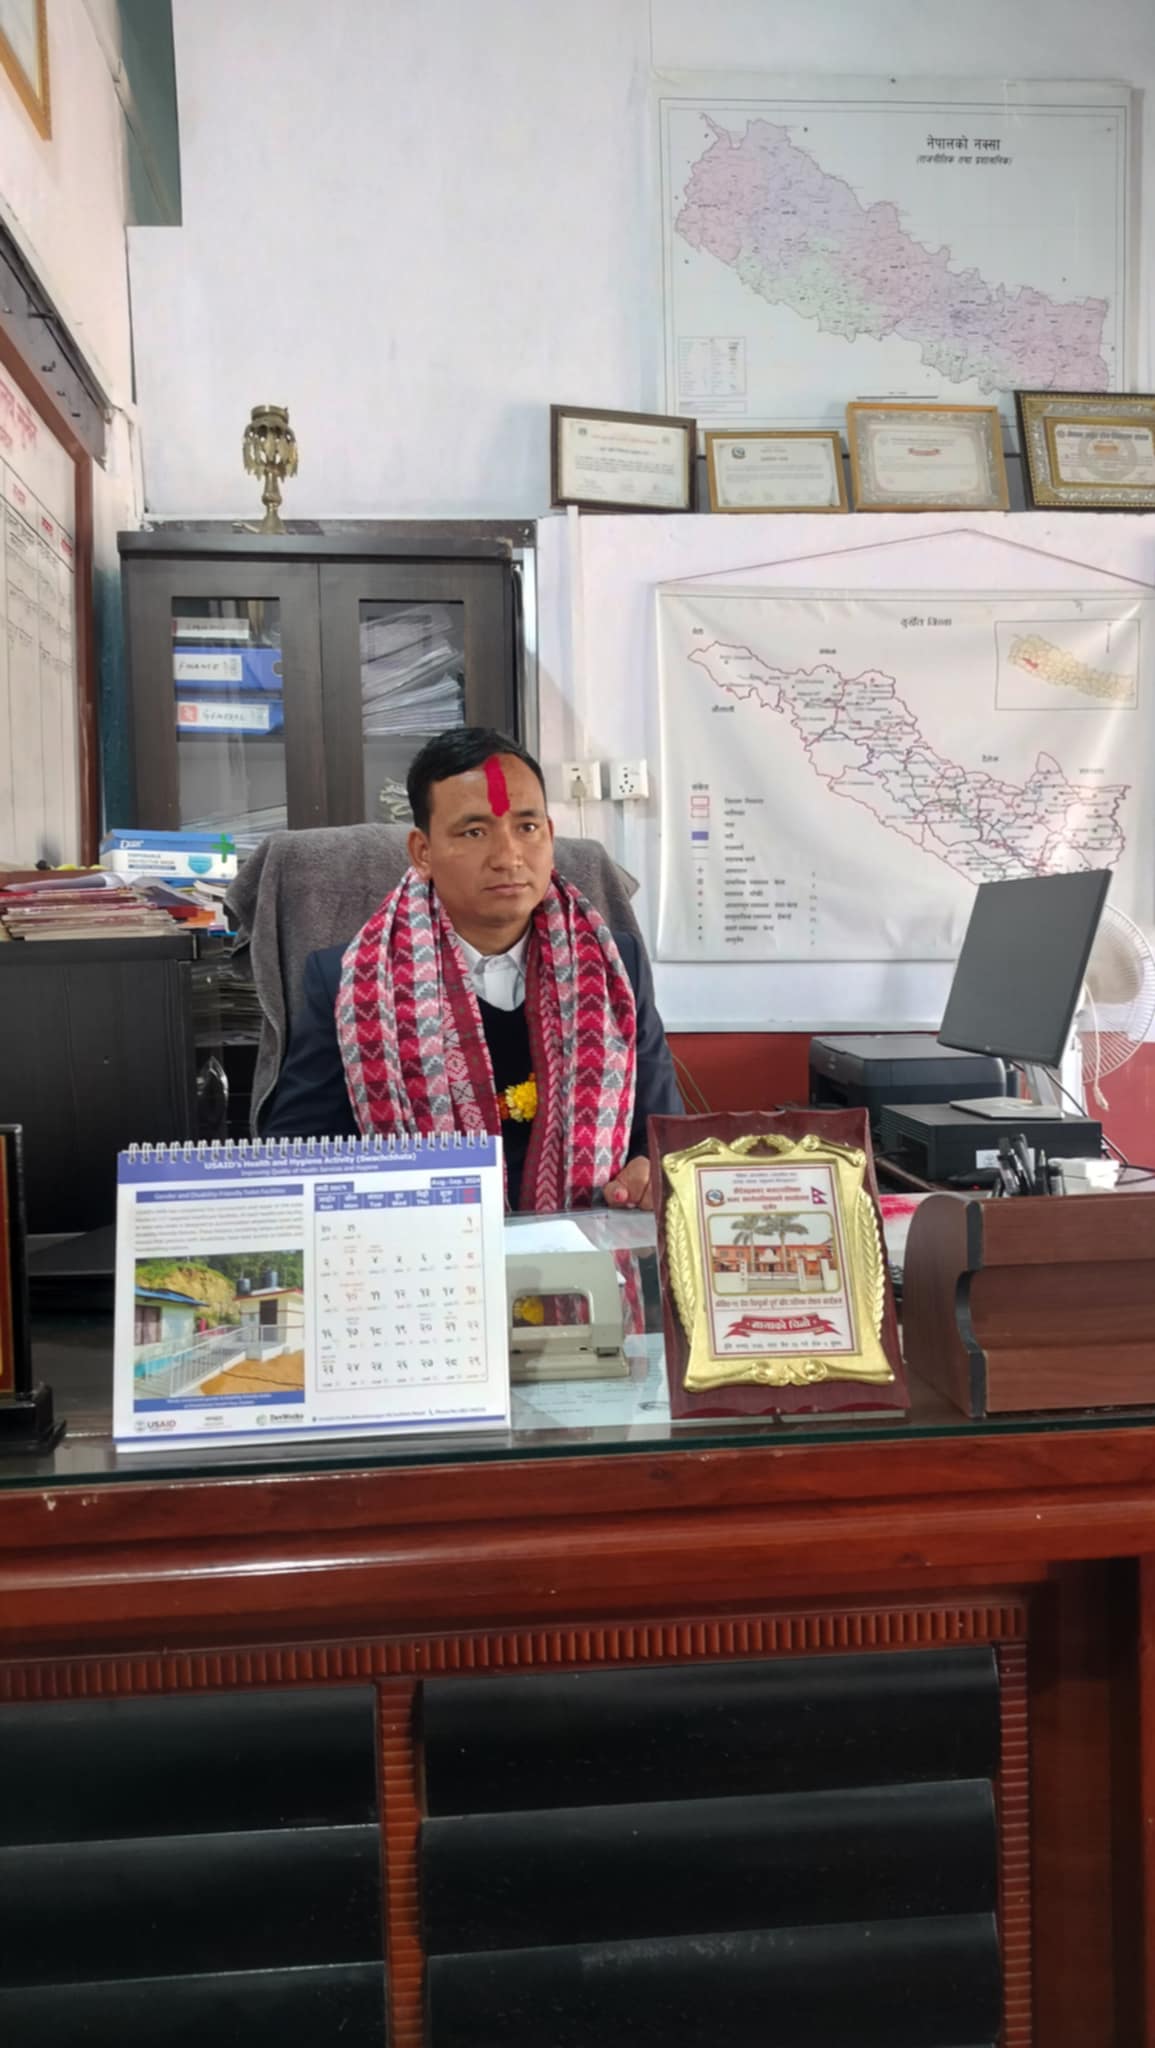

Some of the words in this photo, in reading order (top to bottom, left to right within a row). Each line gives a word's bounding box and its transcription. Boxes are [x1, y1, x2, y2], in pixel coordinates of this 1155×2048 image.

[926, 134, 968, 150] नेपालको
[973, 138, 1001, 150] नक्सा
[147, 1420, 177, 1430] USAID
